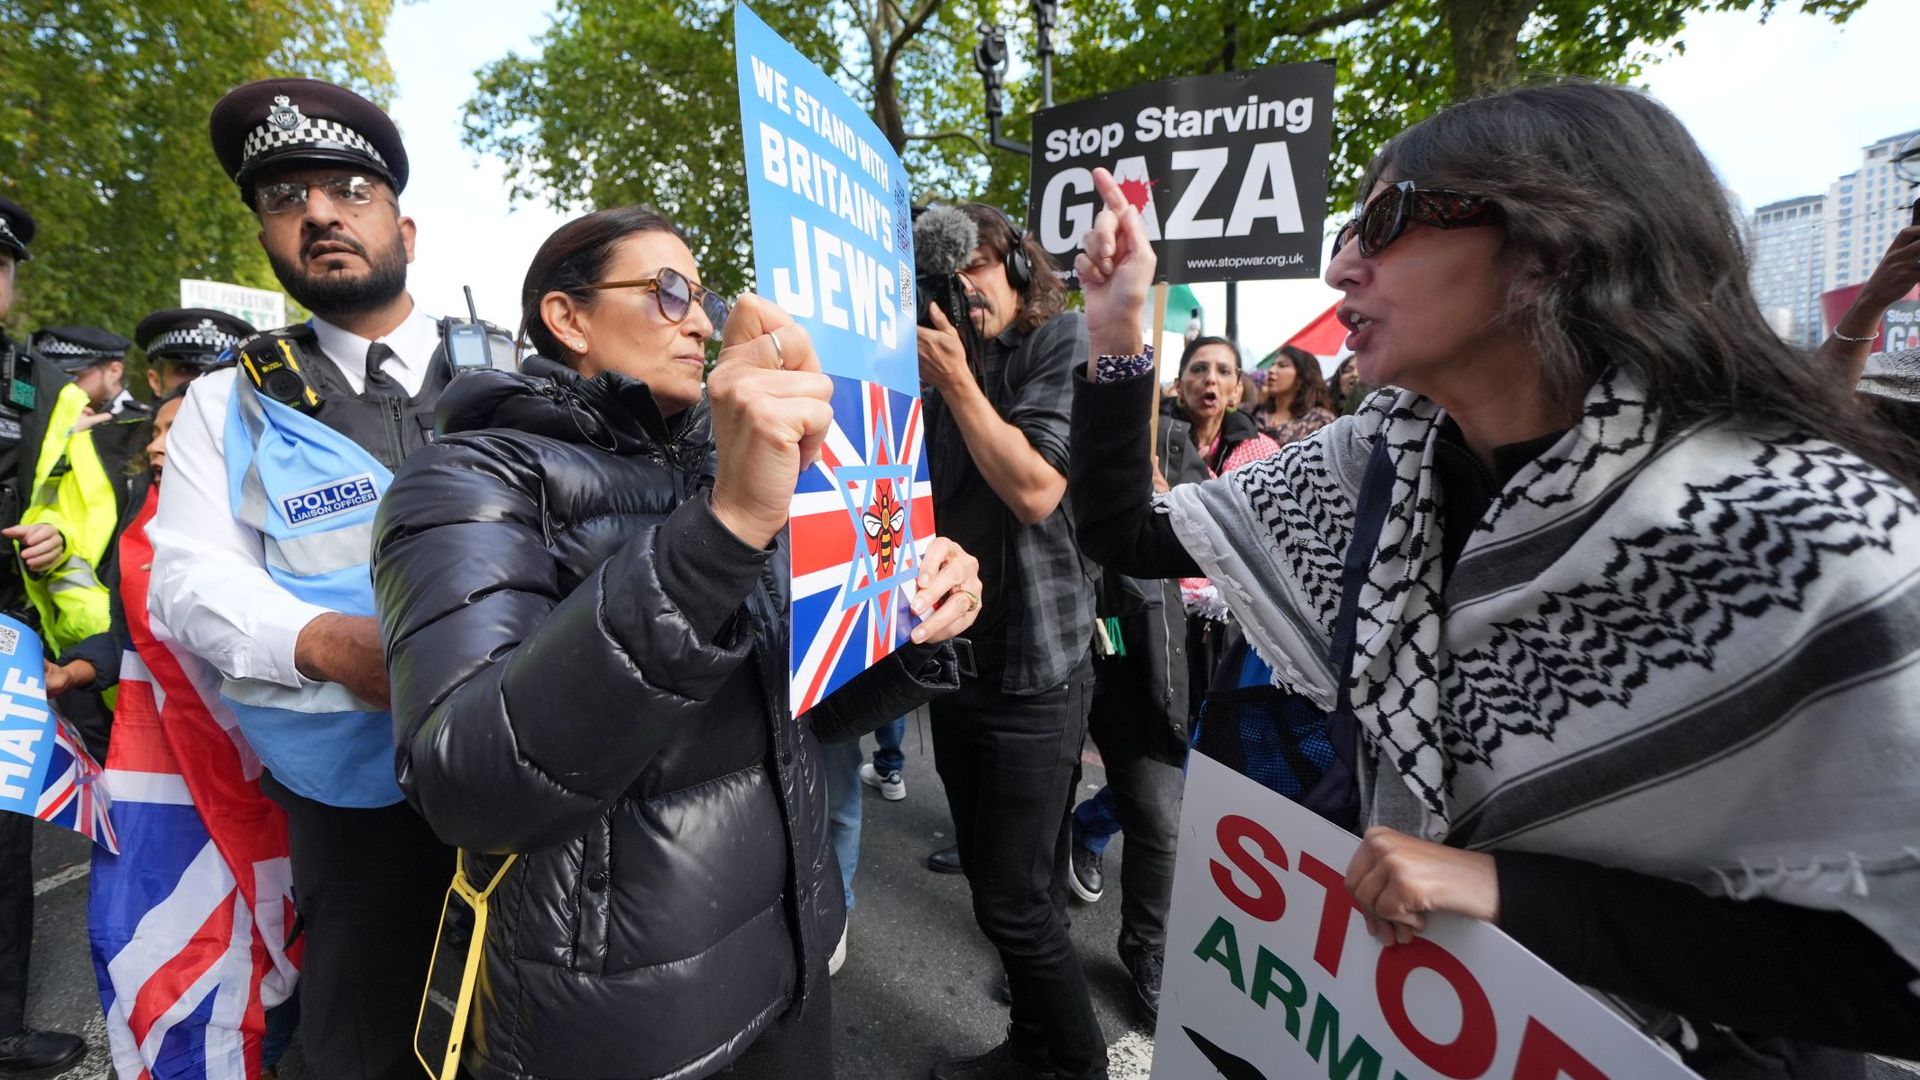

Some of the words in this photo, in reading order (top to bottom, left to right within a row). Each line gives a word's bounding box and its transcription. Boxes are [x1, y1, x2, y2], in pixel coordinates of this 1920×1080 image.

[751, 55, 791, 116] WE
[794, 85, 857, 163] STAND
[858, 136, 889, 193] WITH
[1045, 122, 1124, 163] Stop
[1135, 95, 1314, 143] Starving
[759, 121, 893, 253] BRITAIN'S
[1040, 141, 1305, 255] GAZA
[772, 216, 897, 349] JEWS
[1187, 252, 1304, 270] www.stopwar.org.uk
[287, 479, 373, 515] POLICE
[291, 505, 332, 522] LIAISON
[333, 493, 376, 511] OFFICER
[0, 667, 49, 800] HATE
[1193, 916, 1410, 1080] ARM
